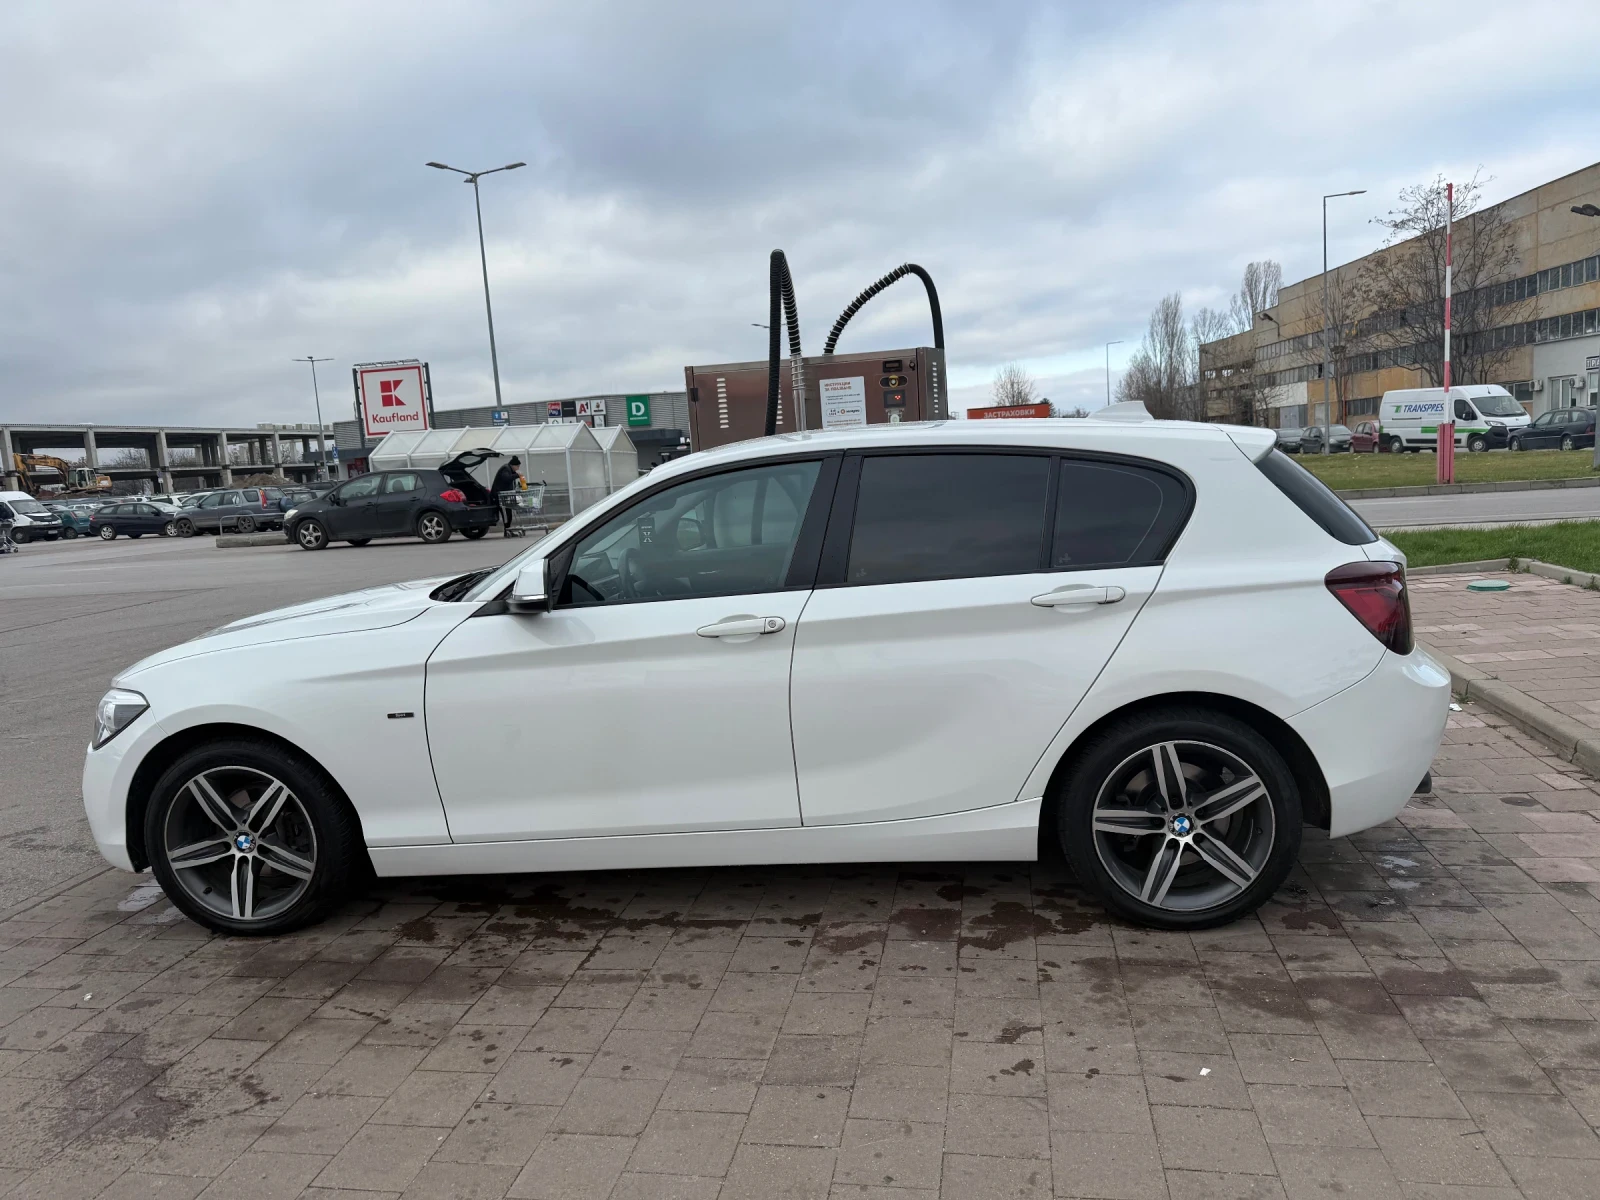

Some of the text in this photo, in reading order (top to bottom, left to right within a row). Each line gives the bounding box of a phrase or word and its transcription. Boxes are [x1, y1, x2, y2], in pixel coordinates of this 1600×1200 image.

[578, 401, 589, 415] A1
[631, 401, 645, 416] D
[984, 408, 1034, 418] ЗАСТРАХОВКИ
[372, 412, 419, 424] Kaufland
